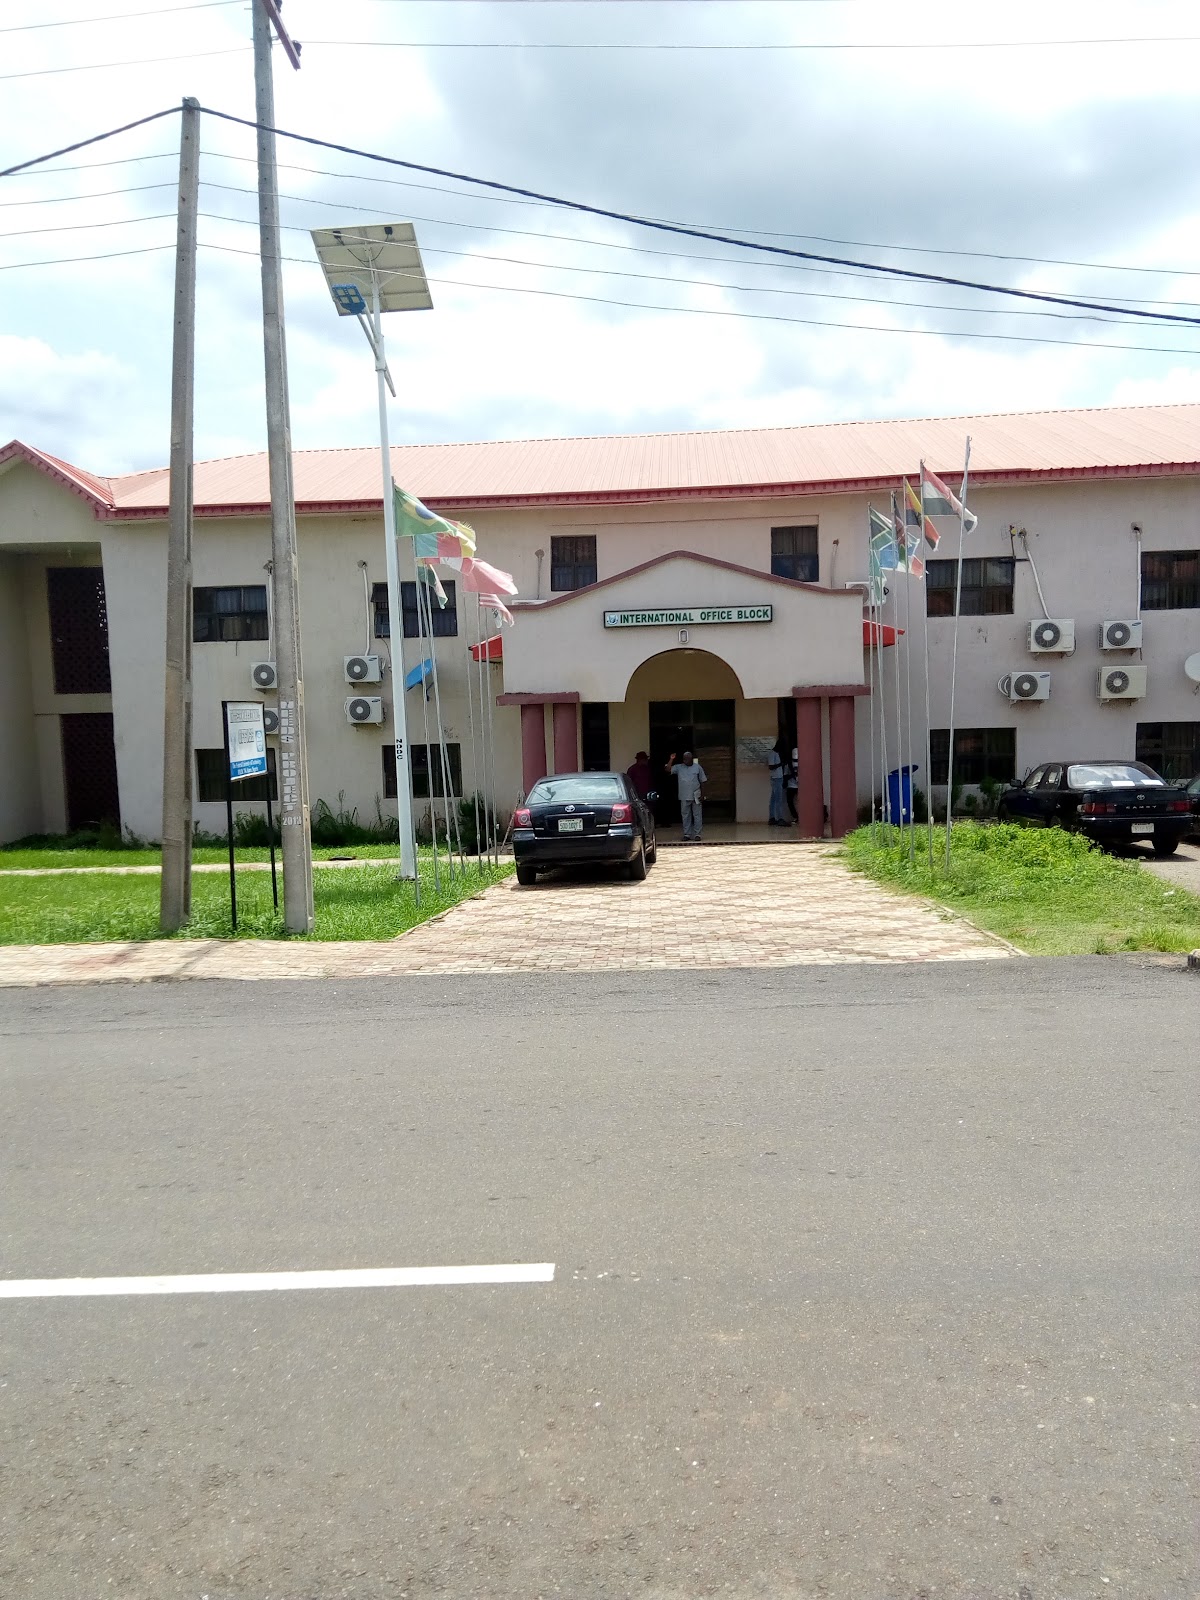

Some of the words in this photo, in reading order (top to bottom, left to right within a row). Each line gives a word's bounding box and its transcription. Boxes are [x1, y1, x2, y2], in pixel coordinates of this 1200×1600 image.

[620, 612, 694, 624] INTERNATIONAL
[700, 610, 732, 621] OFFICE
[737, 608, 769, 619] BLOCK
